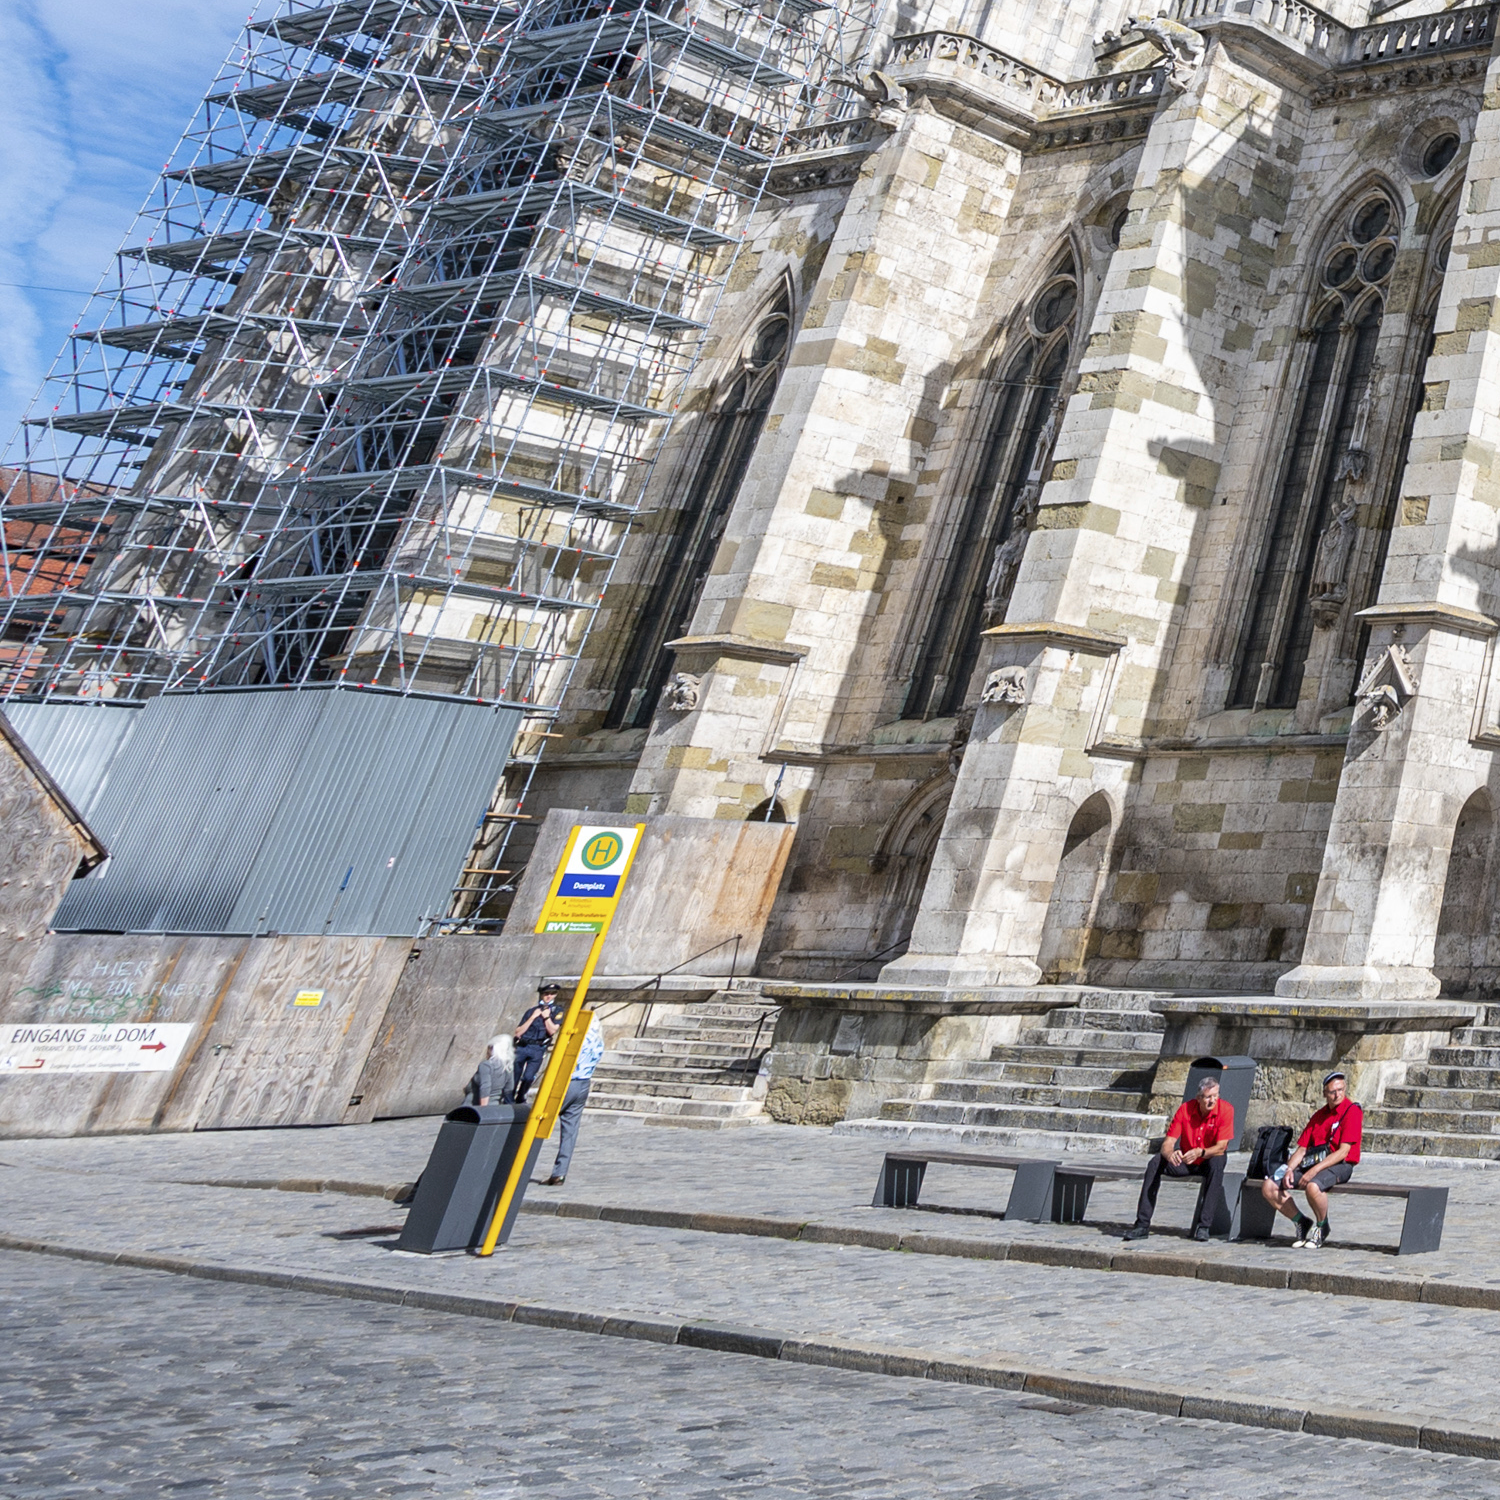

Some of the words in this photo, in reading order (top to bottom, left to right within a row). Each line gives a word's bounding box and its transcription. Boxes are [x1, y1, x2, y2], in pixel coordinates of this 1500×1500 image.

[592, 840, 614, 861] H
[573, 882, 606, 891] Domplatz
[546, 922, 569, 932] RVV
[91, 961, 147, 977] HIER
[11, 1028, 87, 1044] EINGANG
[89, 1033, 112, 1043] ZUM
[115, 1028, 157, 1042] DOM
